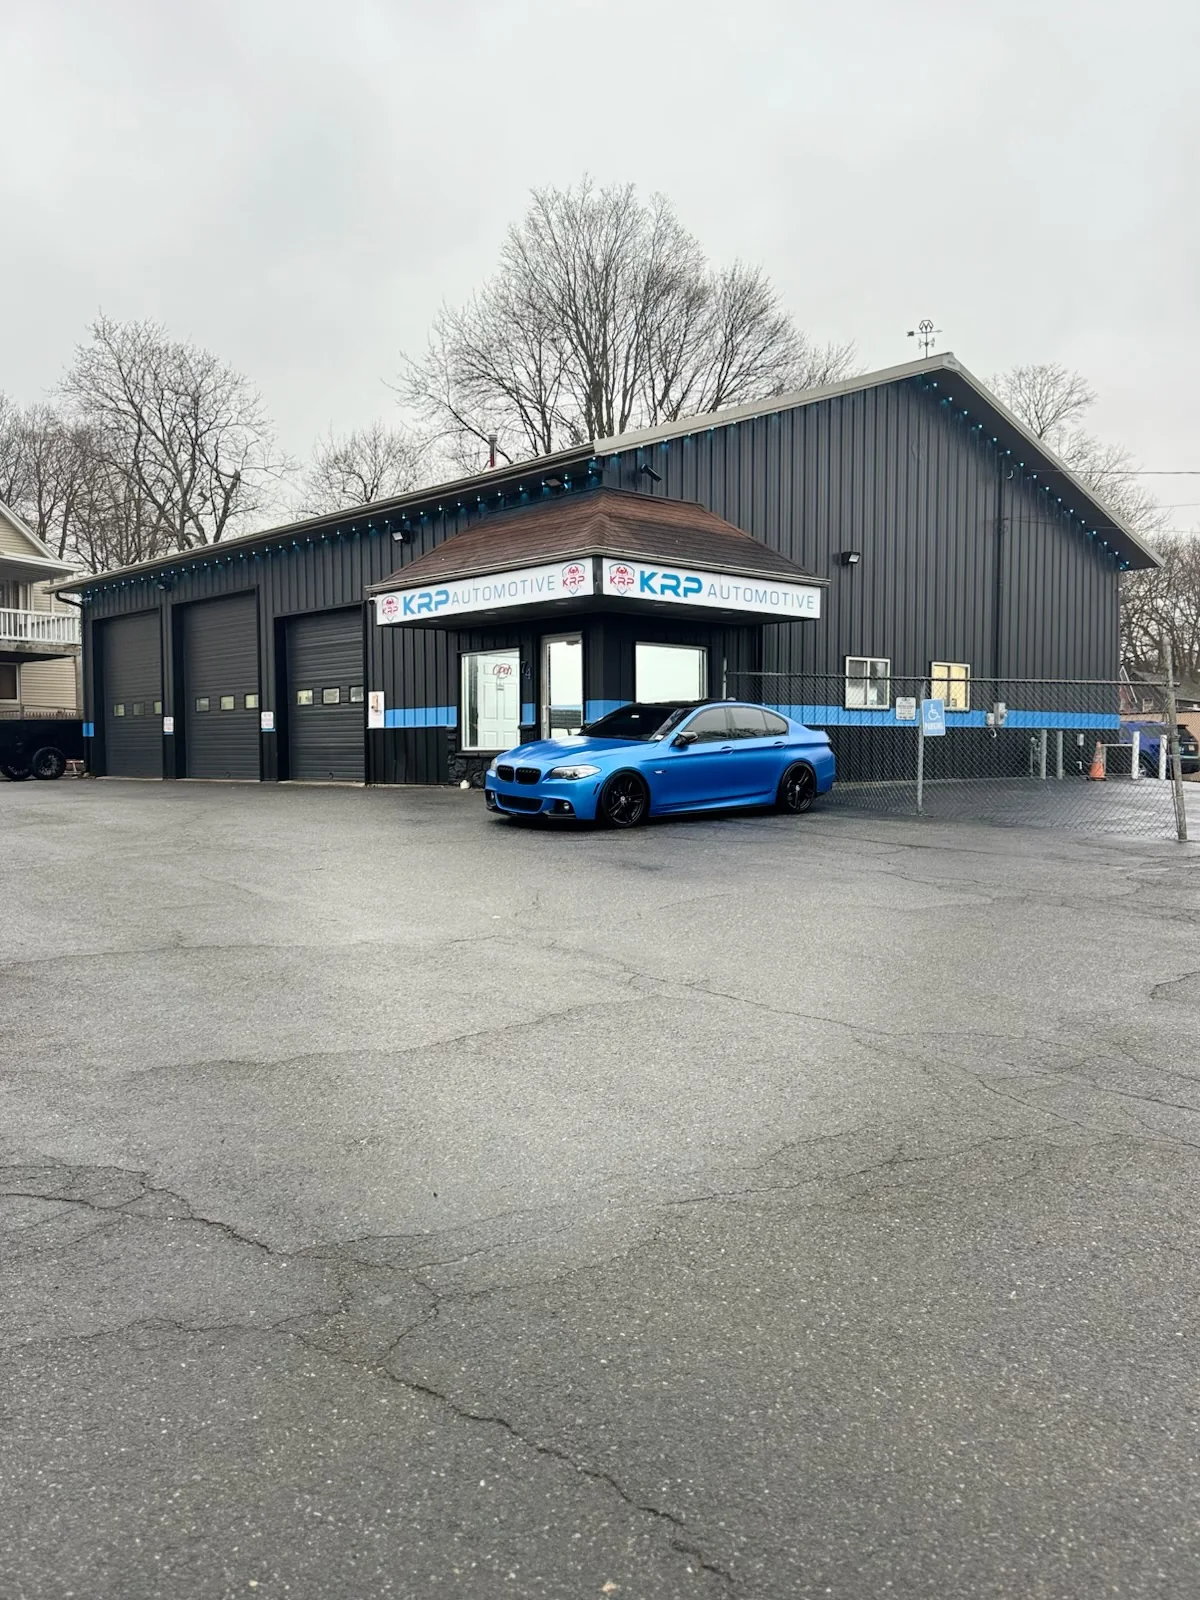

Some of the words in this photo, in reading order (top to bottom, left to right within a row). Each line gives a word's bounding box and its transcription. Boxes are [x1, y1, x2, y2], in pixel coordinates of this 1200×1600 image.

[562, 575, 585, 587] KRP
[609, 575, 635, 587] KRP
[403, 589, 449, 616] KRP
[451, 575, 556, 606] AUTOMOTIVE
[639, 570, 703, 598] KRP
[707, 583, 815, 610] AUTOMOTIVE
[382, 606, 399, 615] KRP
